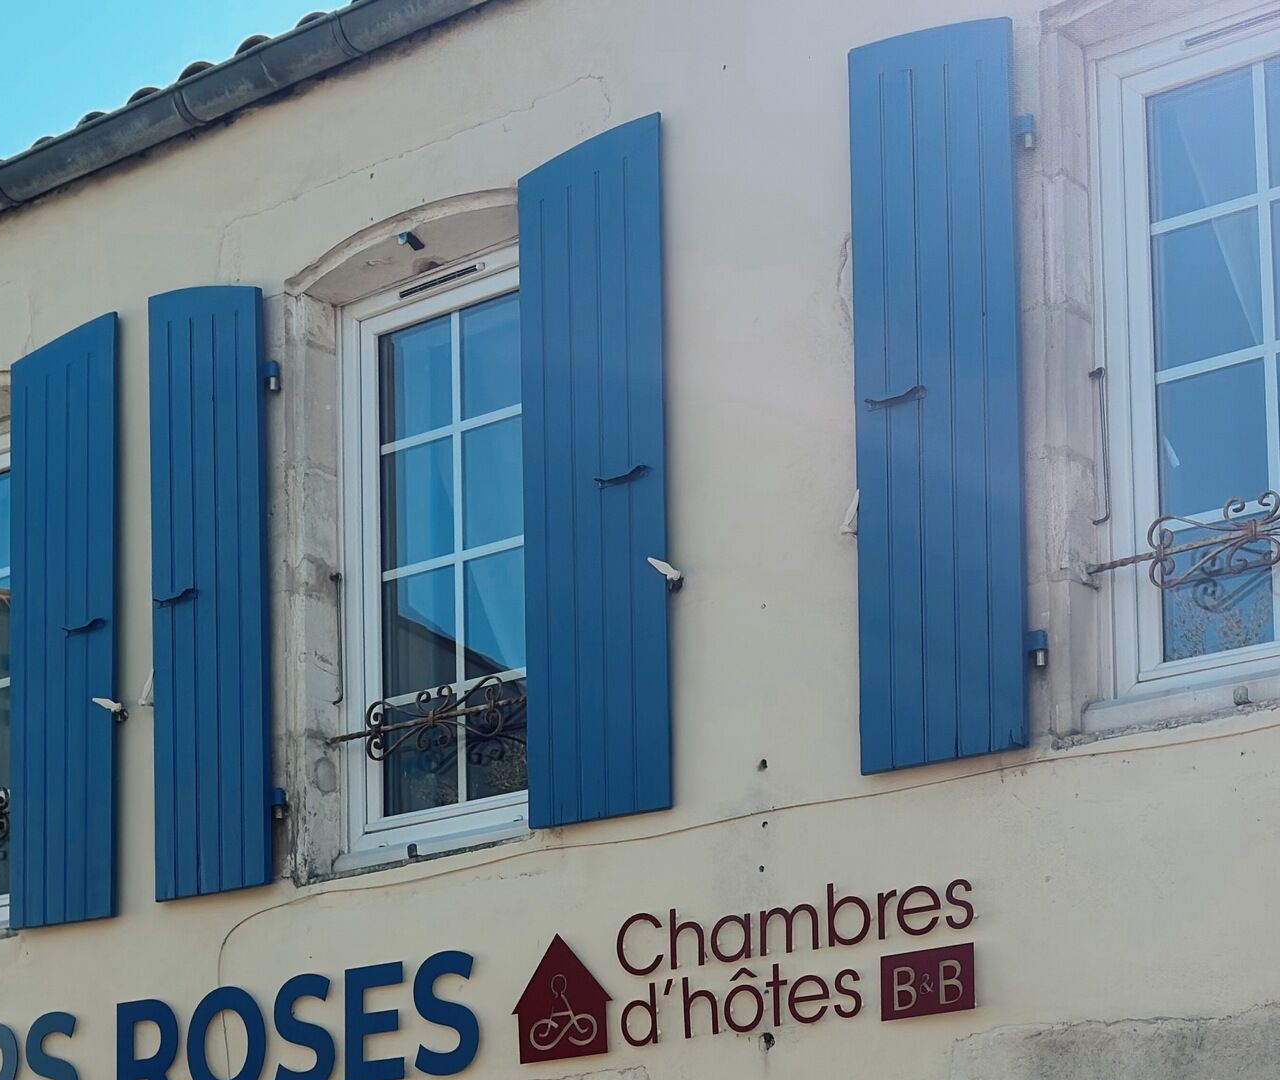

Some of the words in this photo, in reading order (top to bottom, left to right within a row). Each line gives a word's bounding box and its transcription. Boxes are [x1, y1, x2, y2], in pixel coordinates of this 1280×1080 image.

[617, 879, 974, 977] Chambres
[620, 963, 863, 1047] d'hôtes
[892, 959, 965, 1012] B&B
